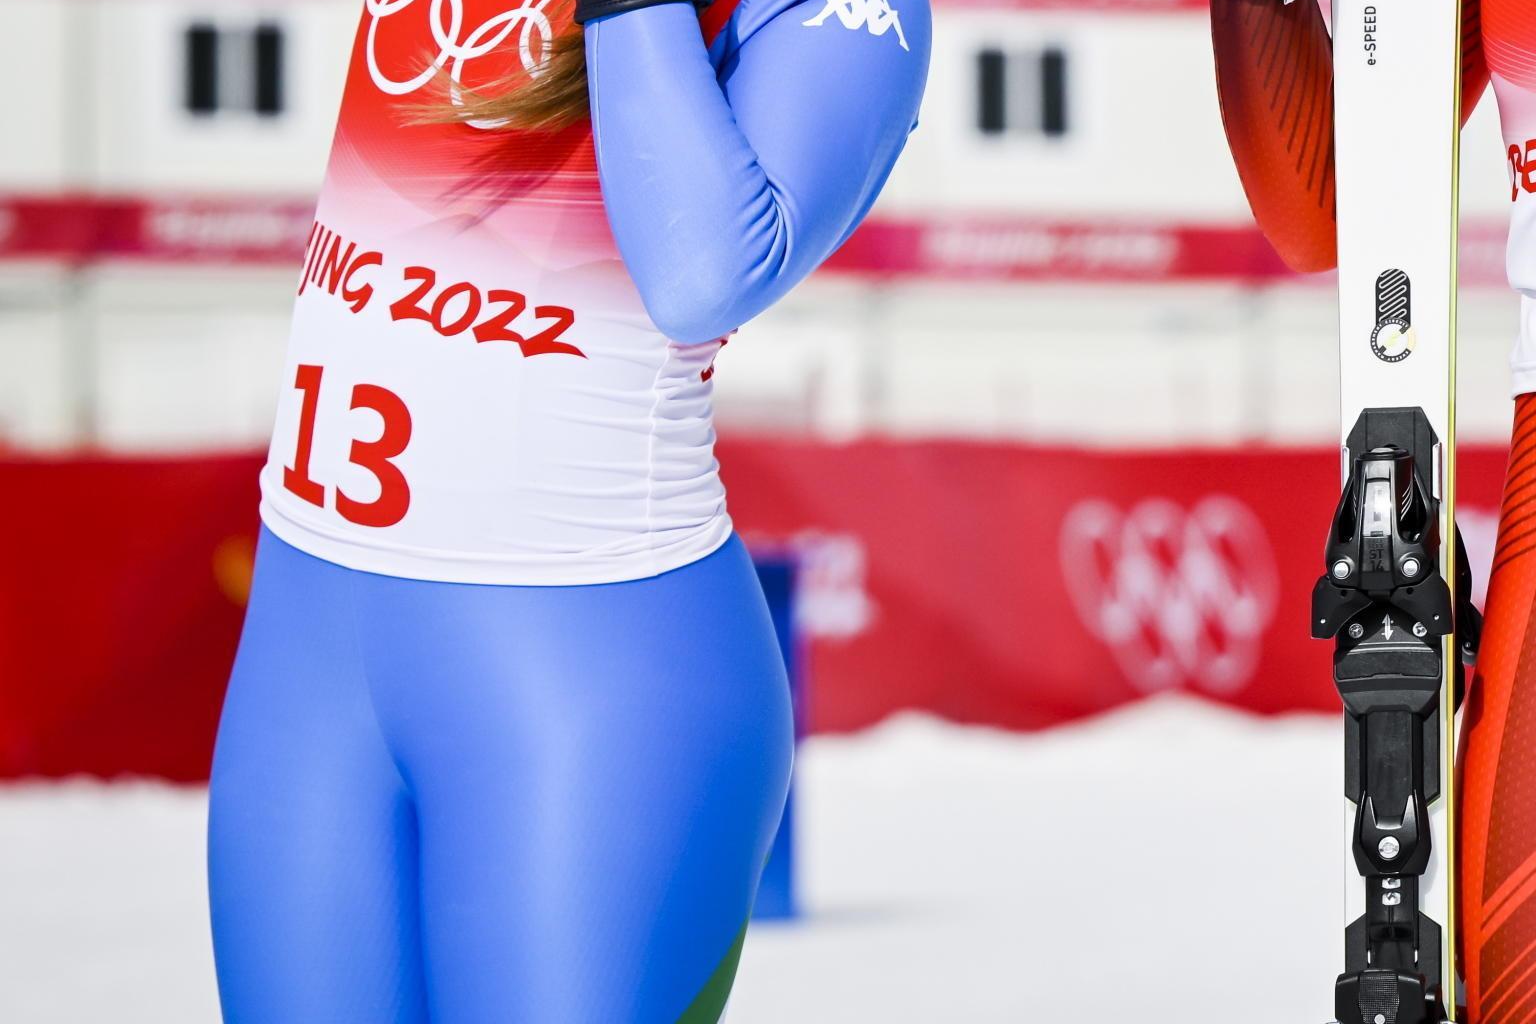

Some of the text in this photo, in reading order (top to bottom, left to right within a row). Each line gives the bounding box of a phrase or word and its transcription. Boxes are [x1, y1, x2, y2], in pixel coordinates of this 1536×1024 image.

[1364, 5, 1377, 66] e-SPEED
[389, 265, 589, 360] 2022
[283, 363, 413, 528] 13
